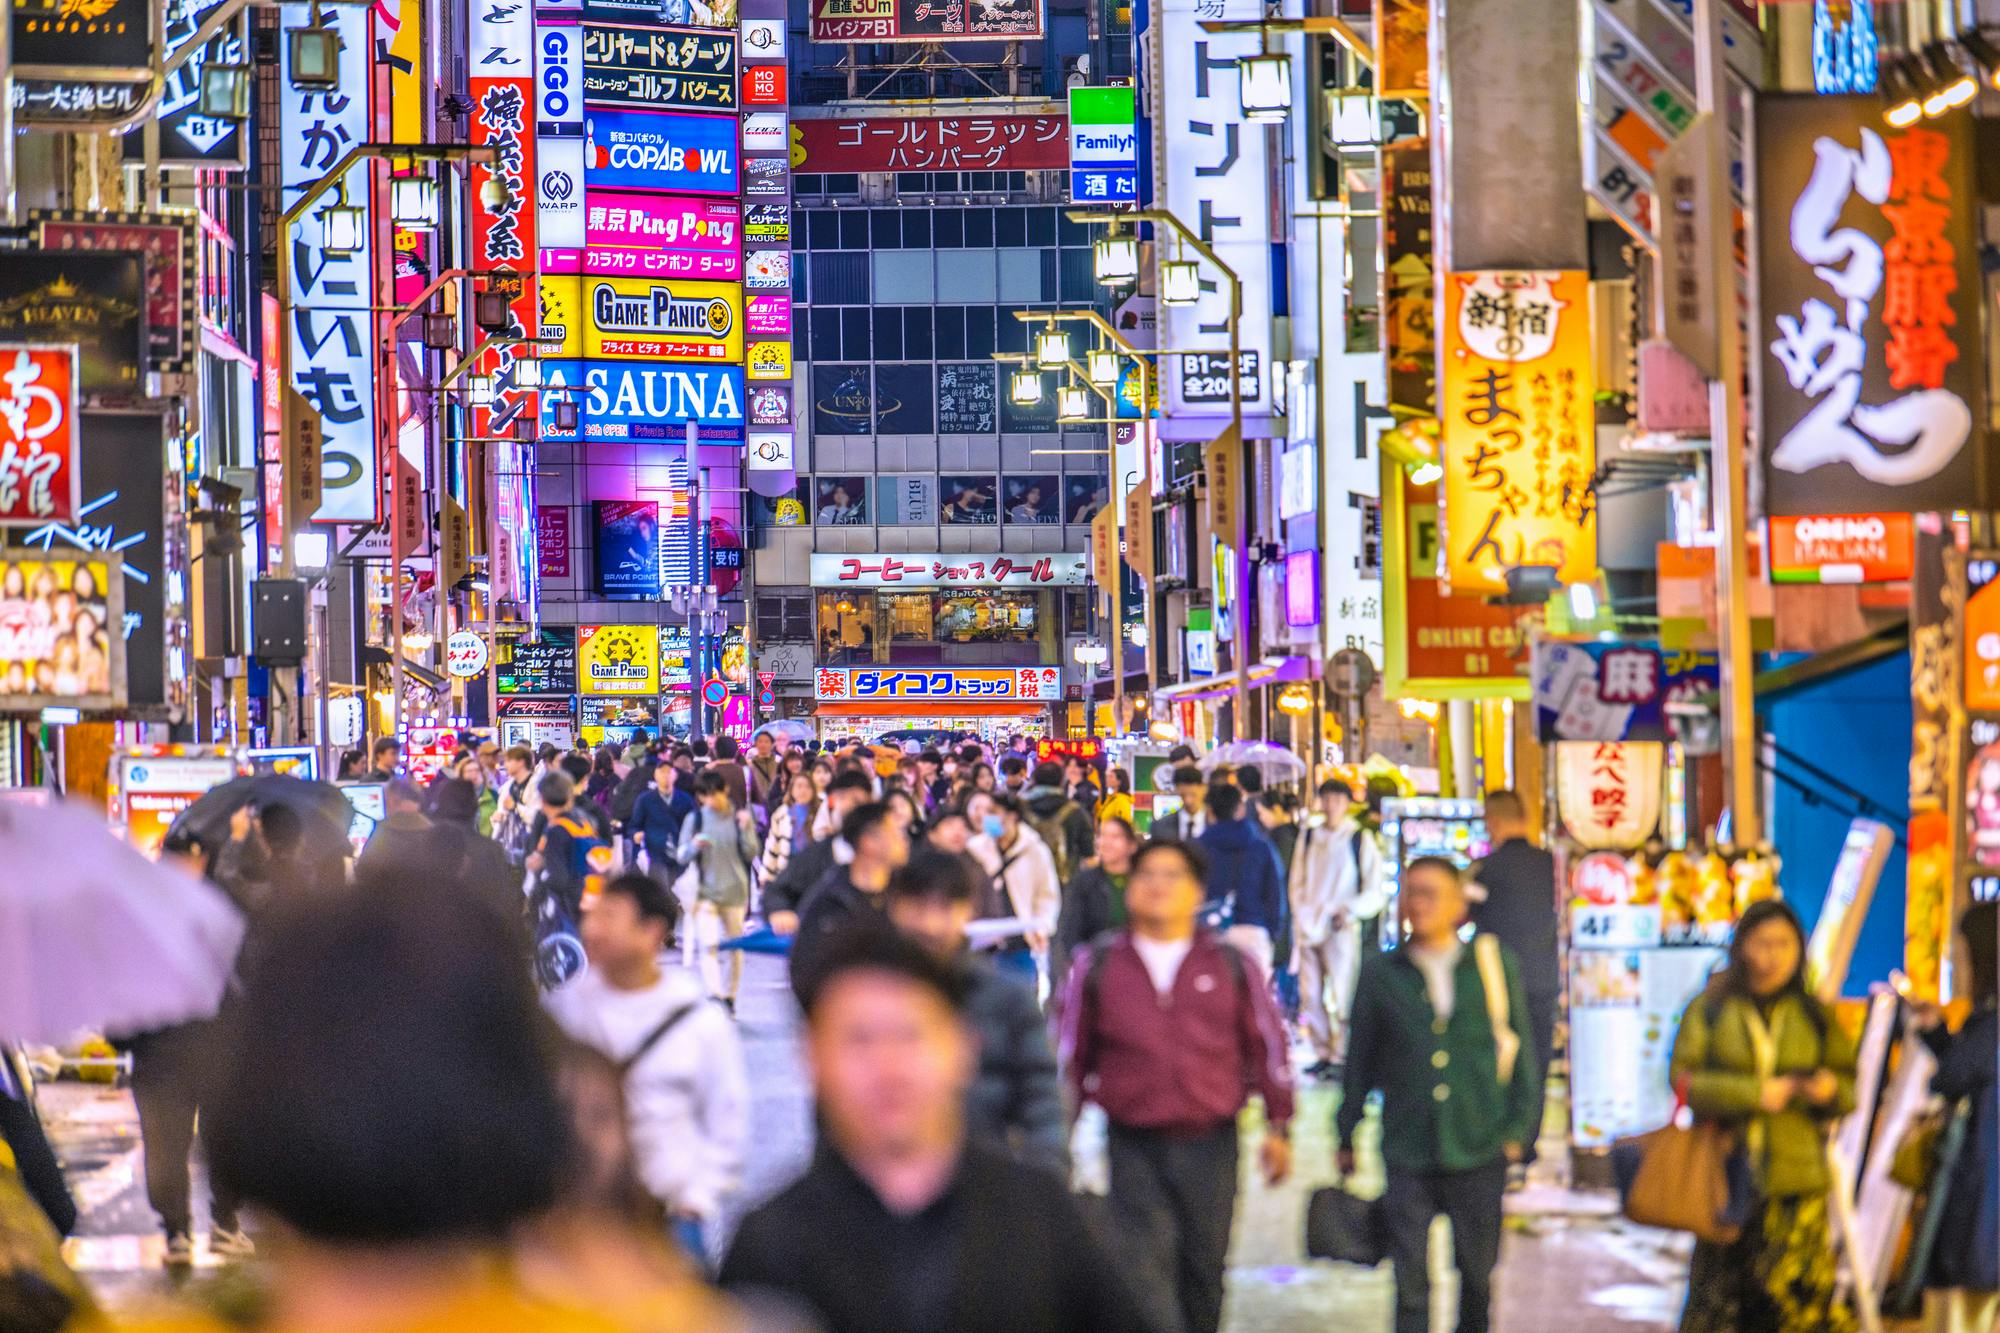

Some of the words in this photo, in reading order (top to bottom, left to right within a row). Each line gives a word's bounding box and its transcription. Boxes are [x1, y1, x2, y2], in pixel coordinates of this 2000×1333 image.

[914, 3, 963, 21] ダーツ
[819, 20, 895, 36] ハイジアB1
[755, 71, 774, 80] MO
[628, 75, 677, 100] ゴルフ
[681, 81, 733, 103] バグース
[755, 83, 774, 93] MO
[837, 119, 1068, 146] ゴールドラッシ
[887, 145, 1007, 168] ハンバーグ
[1084, 174, 1108, 196] 酒
[1115, 175, 1135, 194] た
[588, 206, 625, 232] 東京
[629, 210, 678, 242] Ping
[587, 251, 636, 266] カラオケ
[700, 261, 736, 274] ダーツ
[585, 369, 743, 419] SAUNA
[603, 425, 628, 437] OPEN
[1117, 427, 1131, 439] 2F
[839, 556, 926, 582] コーヒー
[932, 560, 985, 581] ショップ
[990, 556, 1054, 583] クール
[771, 660, 798, 673] AXY
[819, 668, 846, 697] 薬
[1019, 668, 1039, 698] 免税
